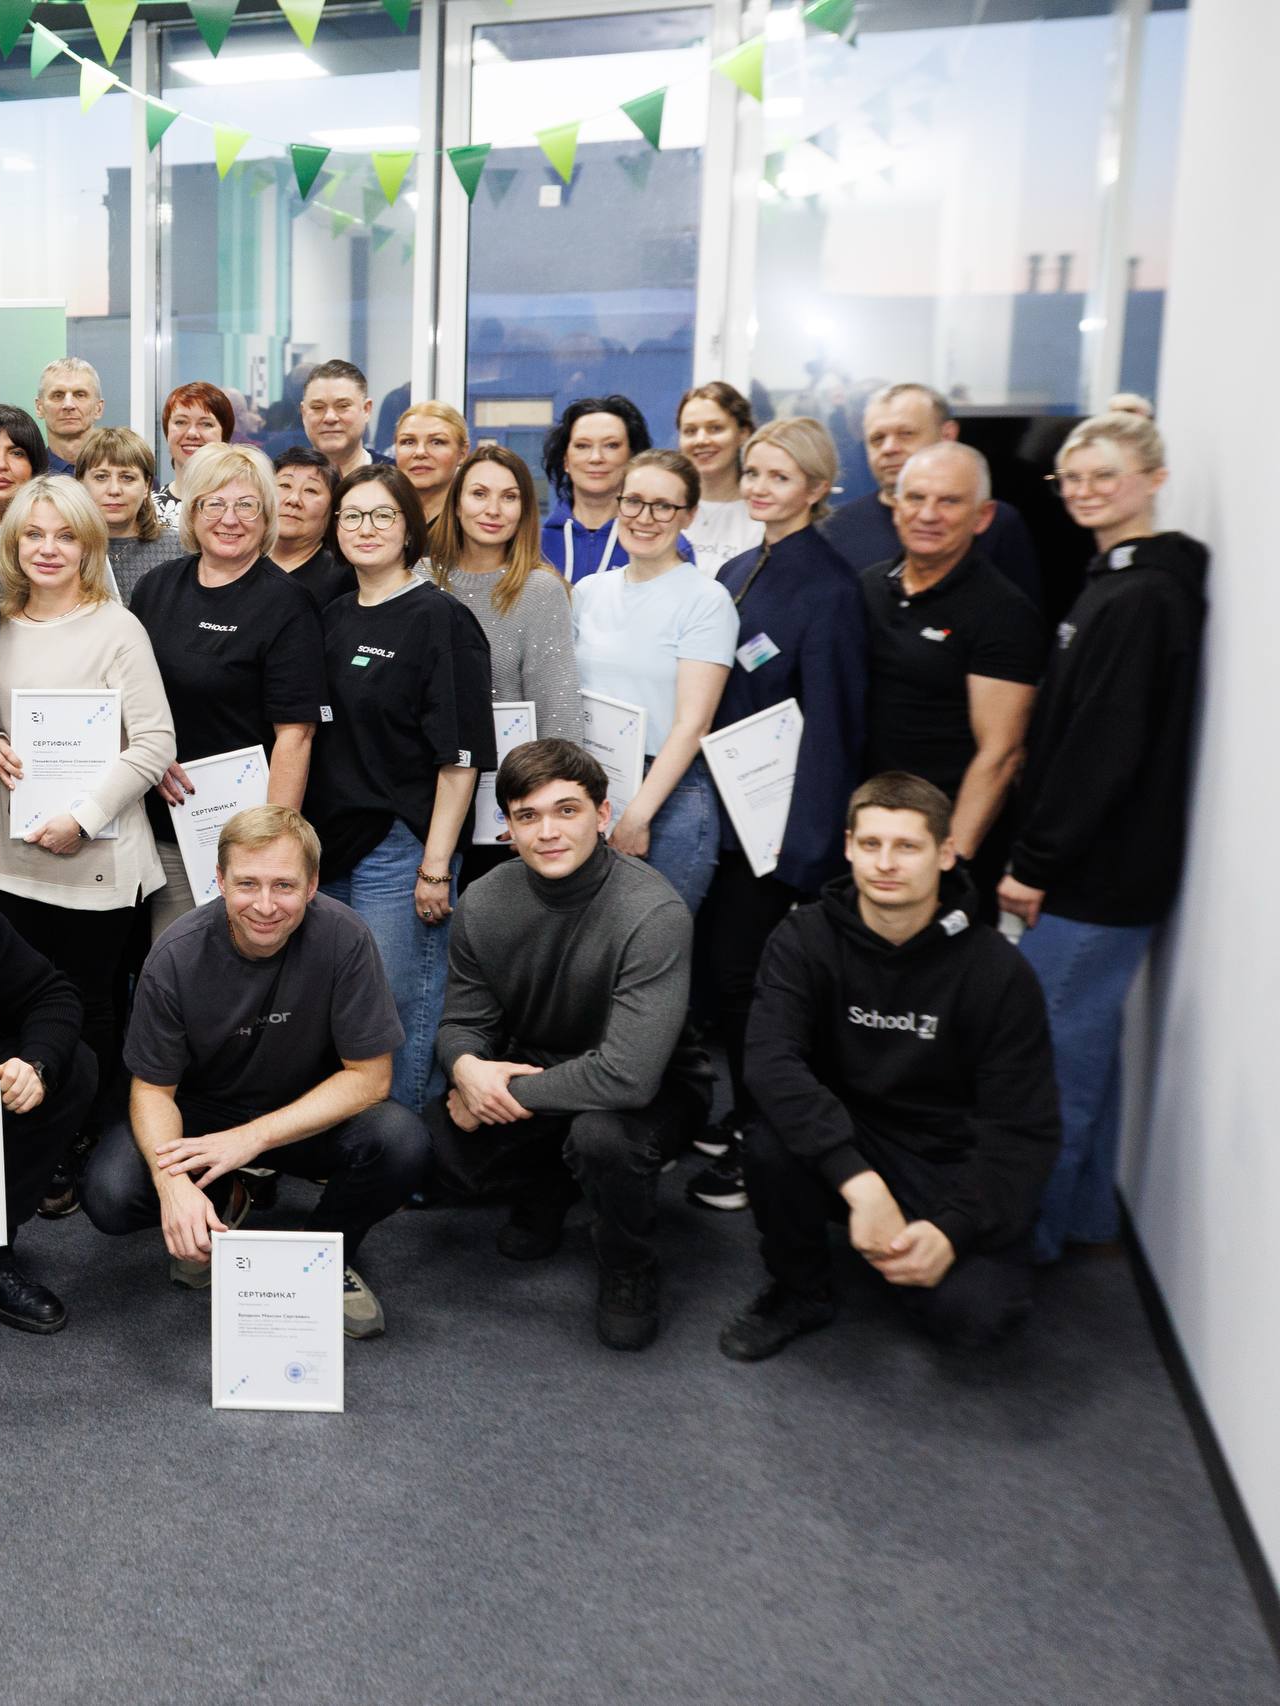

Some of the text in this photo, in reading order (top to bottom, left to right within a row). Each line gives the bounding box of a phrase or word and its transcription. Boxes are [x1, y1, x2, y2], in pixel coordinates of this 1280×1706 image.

[199, 621, 228, 632] SCHOOL
[357, 645, 395, 659] SCHOOL 21
[191, 802, 237, 816] СЕРТИФИКАТ
[847, 1006, 939, 1039] School 21
[238, 1291, 296, 1299] СЕРТИФИКАТ
